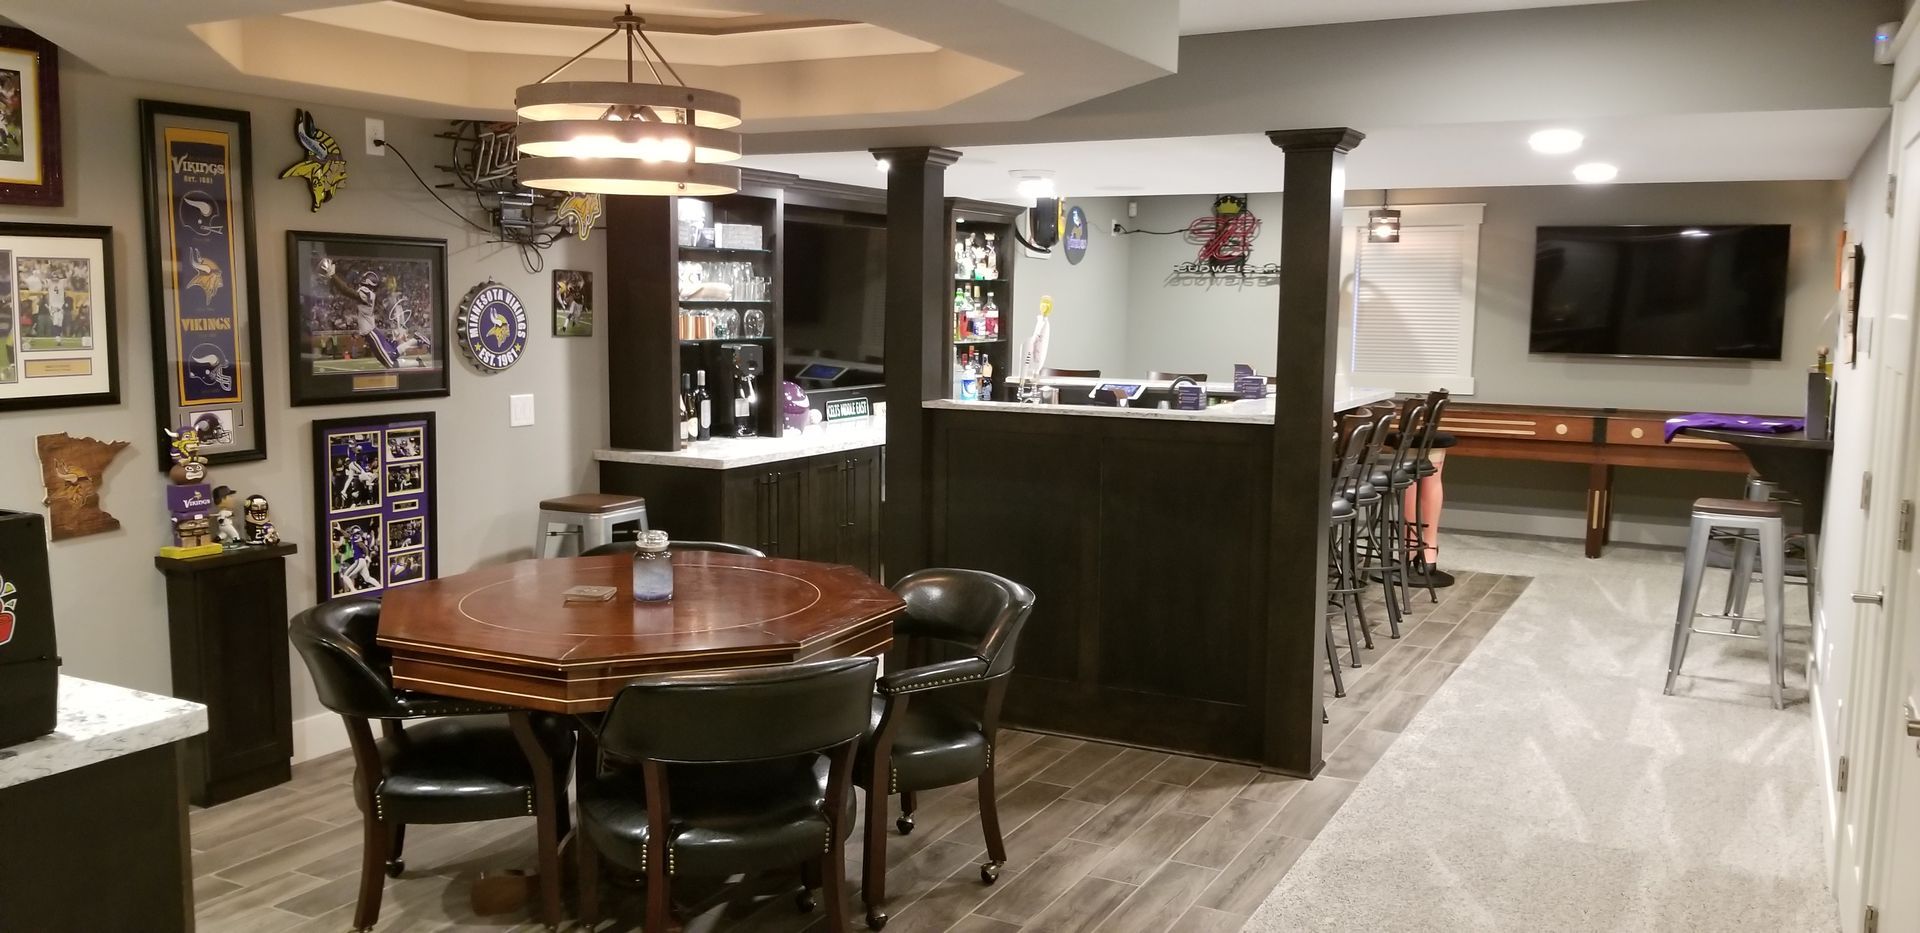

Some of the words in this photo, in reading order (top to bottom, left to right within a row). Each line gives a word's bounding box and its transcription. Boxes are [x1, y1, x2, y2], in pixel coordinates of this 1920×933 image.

[172, 152, 225, 176] VIKINGS
[469, 288, 504, 338] MINNESOTA
[505, 292, 527, 338] VIKINGS
[181, 317, 231, 331] VIKINGS
[478, 347, 496, 367] EST.
[497, 347, 519, 367] 1961
[855, 400, 867, 415] EAST
[183, 498, 211, 508] VIKINGS
